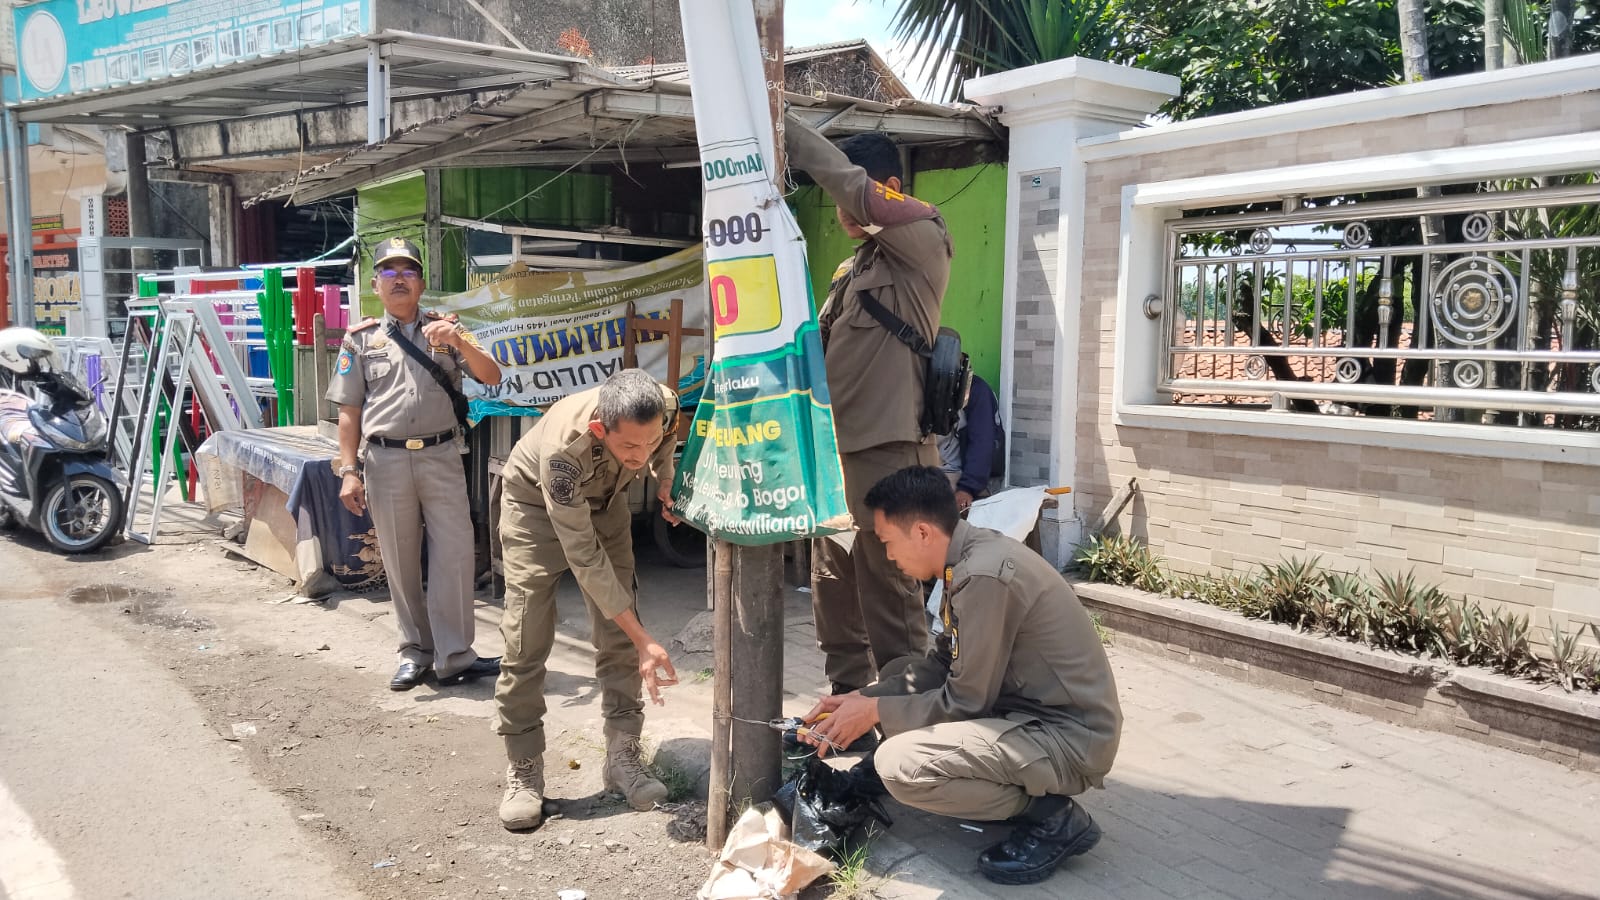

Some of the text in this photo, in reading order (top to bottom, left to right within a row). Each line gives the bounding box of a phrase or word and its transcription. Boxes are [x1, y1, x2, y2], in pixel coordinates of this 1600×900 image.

[519, 291, 581, 308] Peringatan
[526, 321, 547, 330] 1445
[550, 318, 572, 326] Awal
